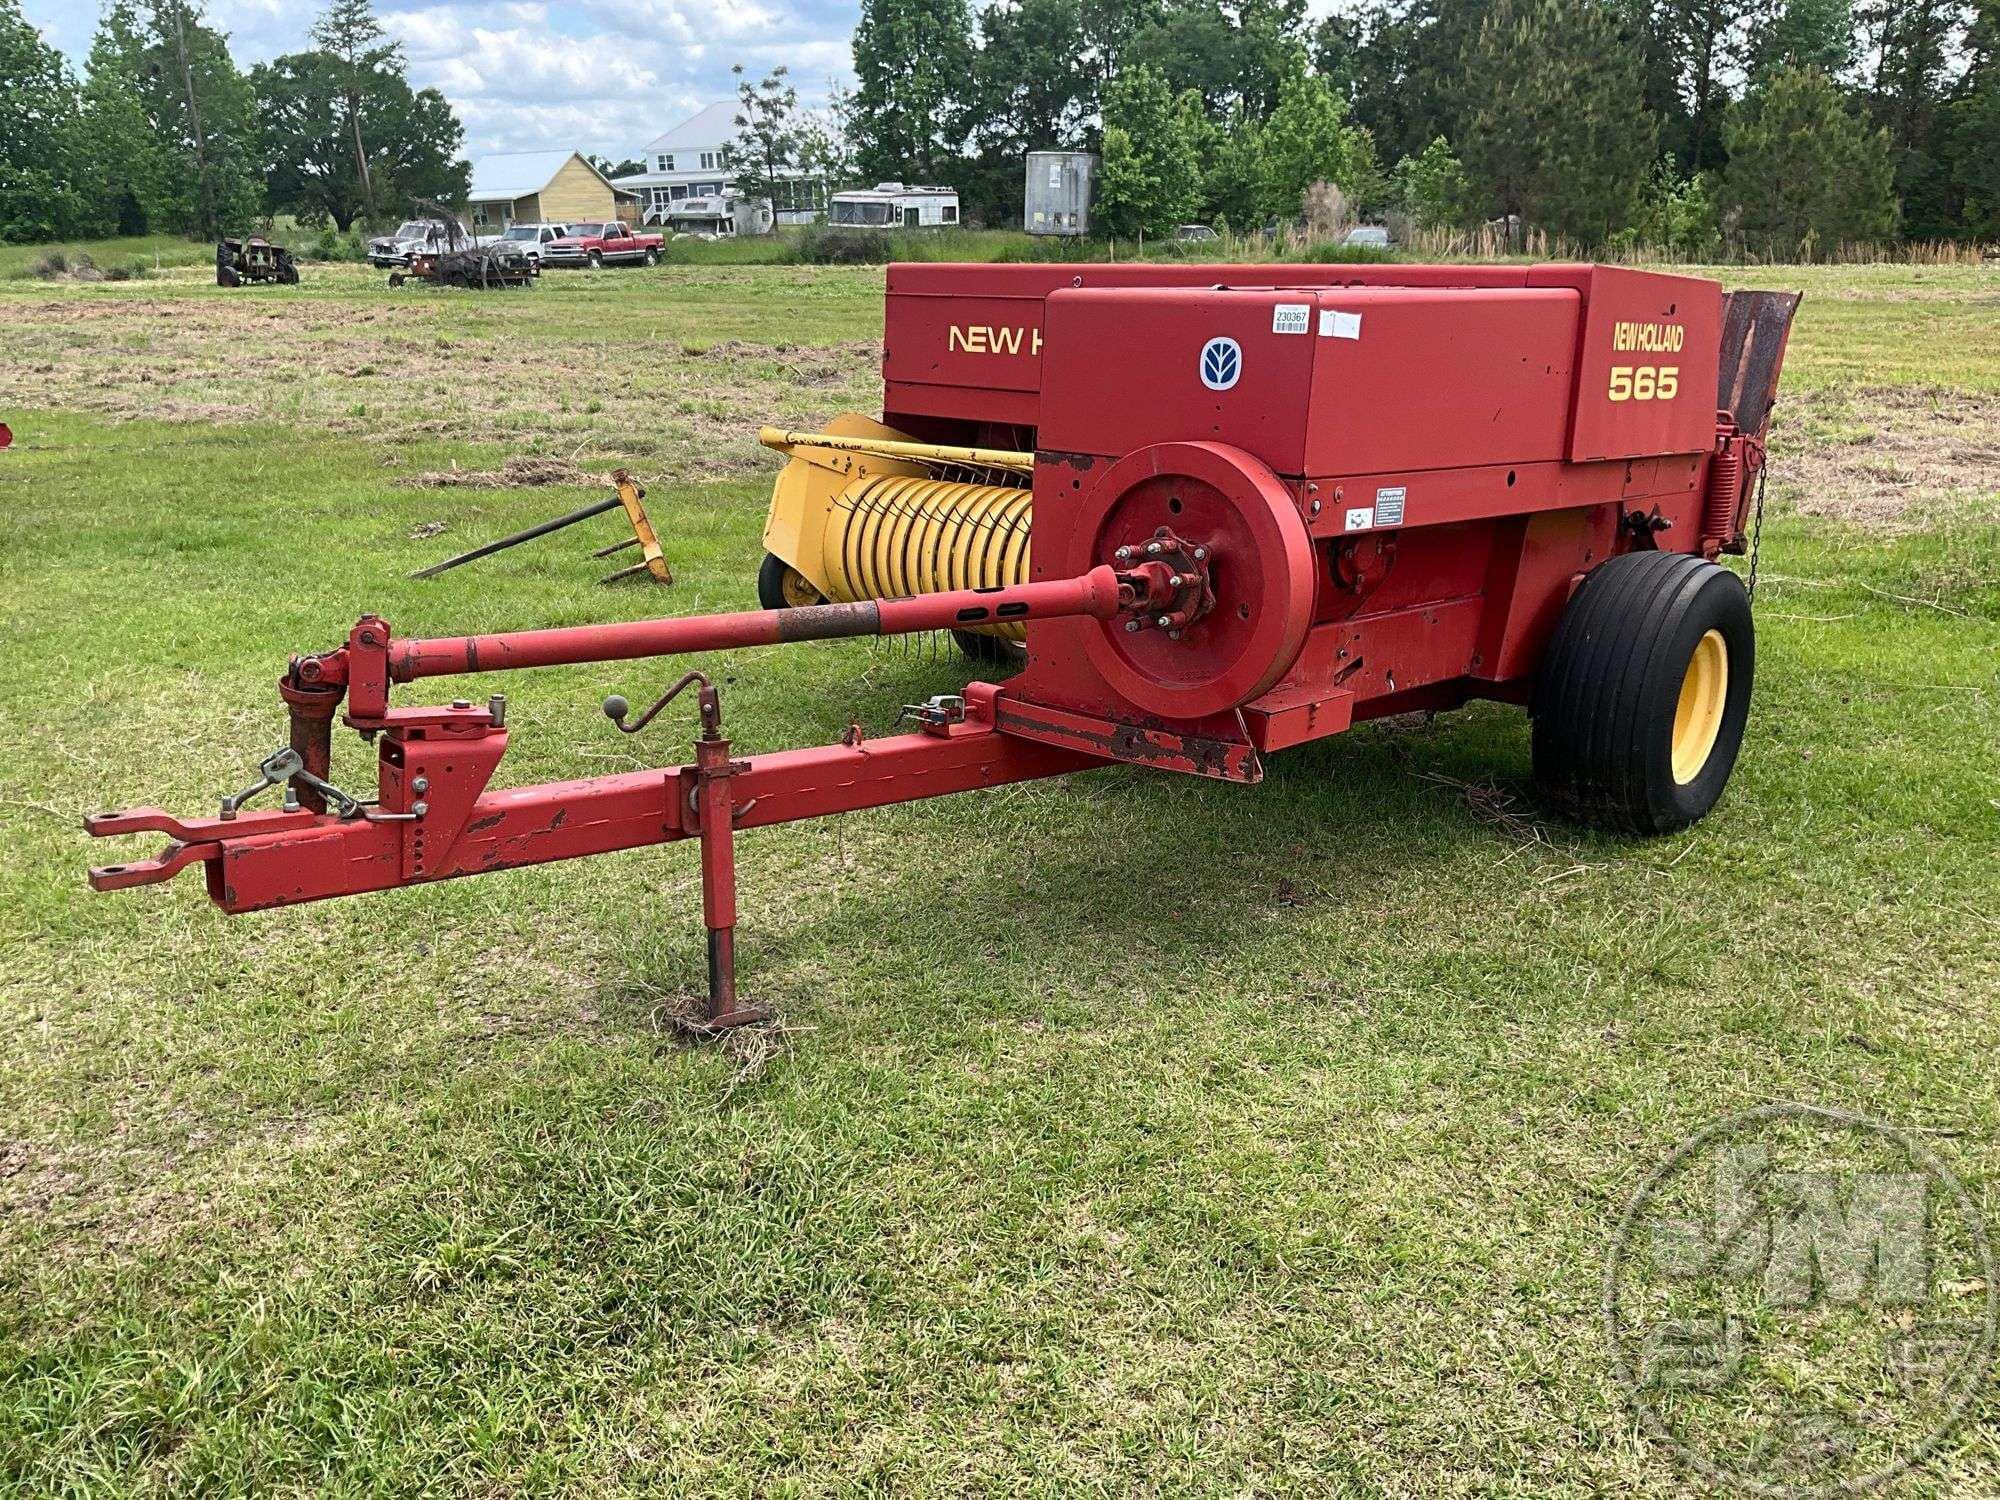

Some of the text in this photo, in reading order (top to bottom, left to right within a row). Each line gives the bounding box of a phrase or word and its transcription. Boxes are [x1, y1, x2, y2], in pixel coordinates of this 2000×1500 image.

[1276, 311, 1307, 322] 230367
[948, 325, 1024, 355] NEW
[1608, 366, 1680, 401] 565
